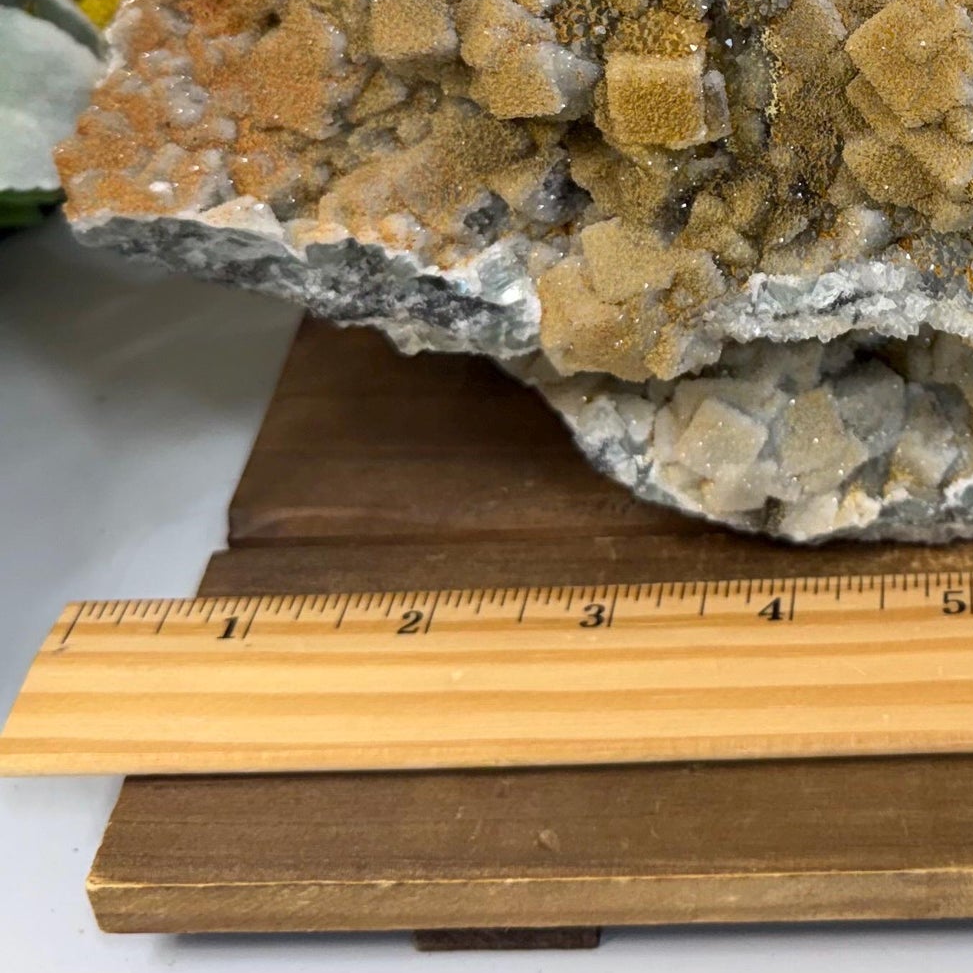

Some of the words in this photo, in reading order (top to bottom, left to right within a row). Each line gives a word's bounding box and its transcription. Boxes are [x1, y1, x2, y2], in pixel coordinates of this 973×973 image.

[217, 617, 240, 639] 1
[397, 611, 424, 635] 2
[580, 604, 605, 628] 3
[758, 597, 785, 622] 4
[942, 590, 967, 615] 5
